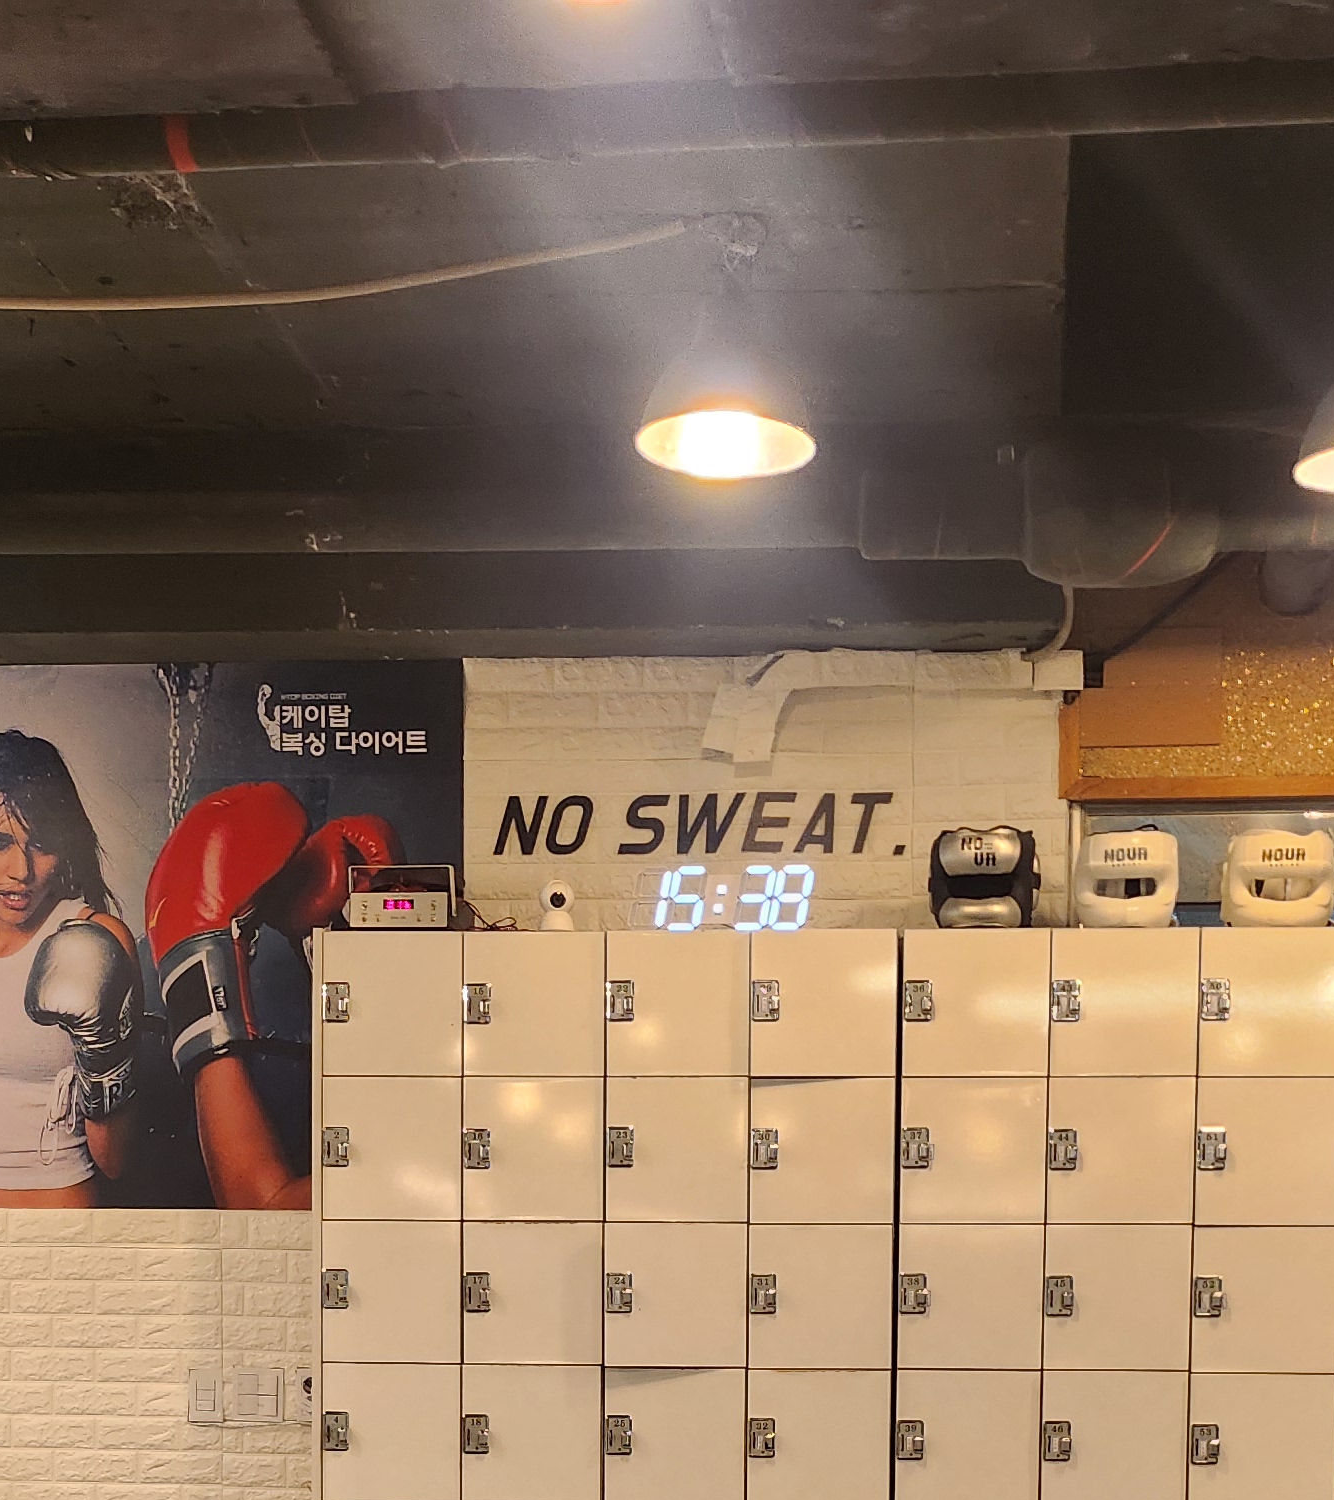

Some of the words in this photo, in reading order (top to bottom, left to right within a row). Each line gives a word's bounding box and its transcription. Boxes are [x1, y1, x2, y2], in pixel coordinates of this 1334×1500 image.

[281, 704, 351, 728] 케이탑
[281, 732, 326, 756] 복싱
[334, 730, 427, 755] 다이어트
[493, 795, 594, 855] NO
[617, 791, 907, 855] SWEAT.
[654, 863, 815, 932] 15:38
